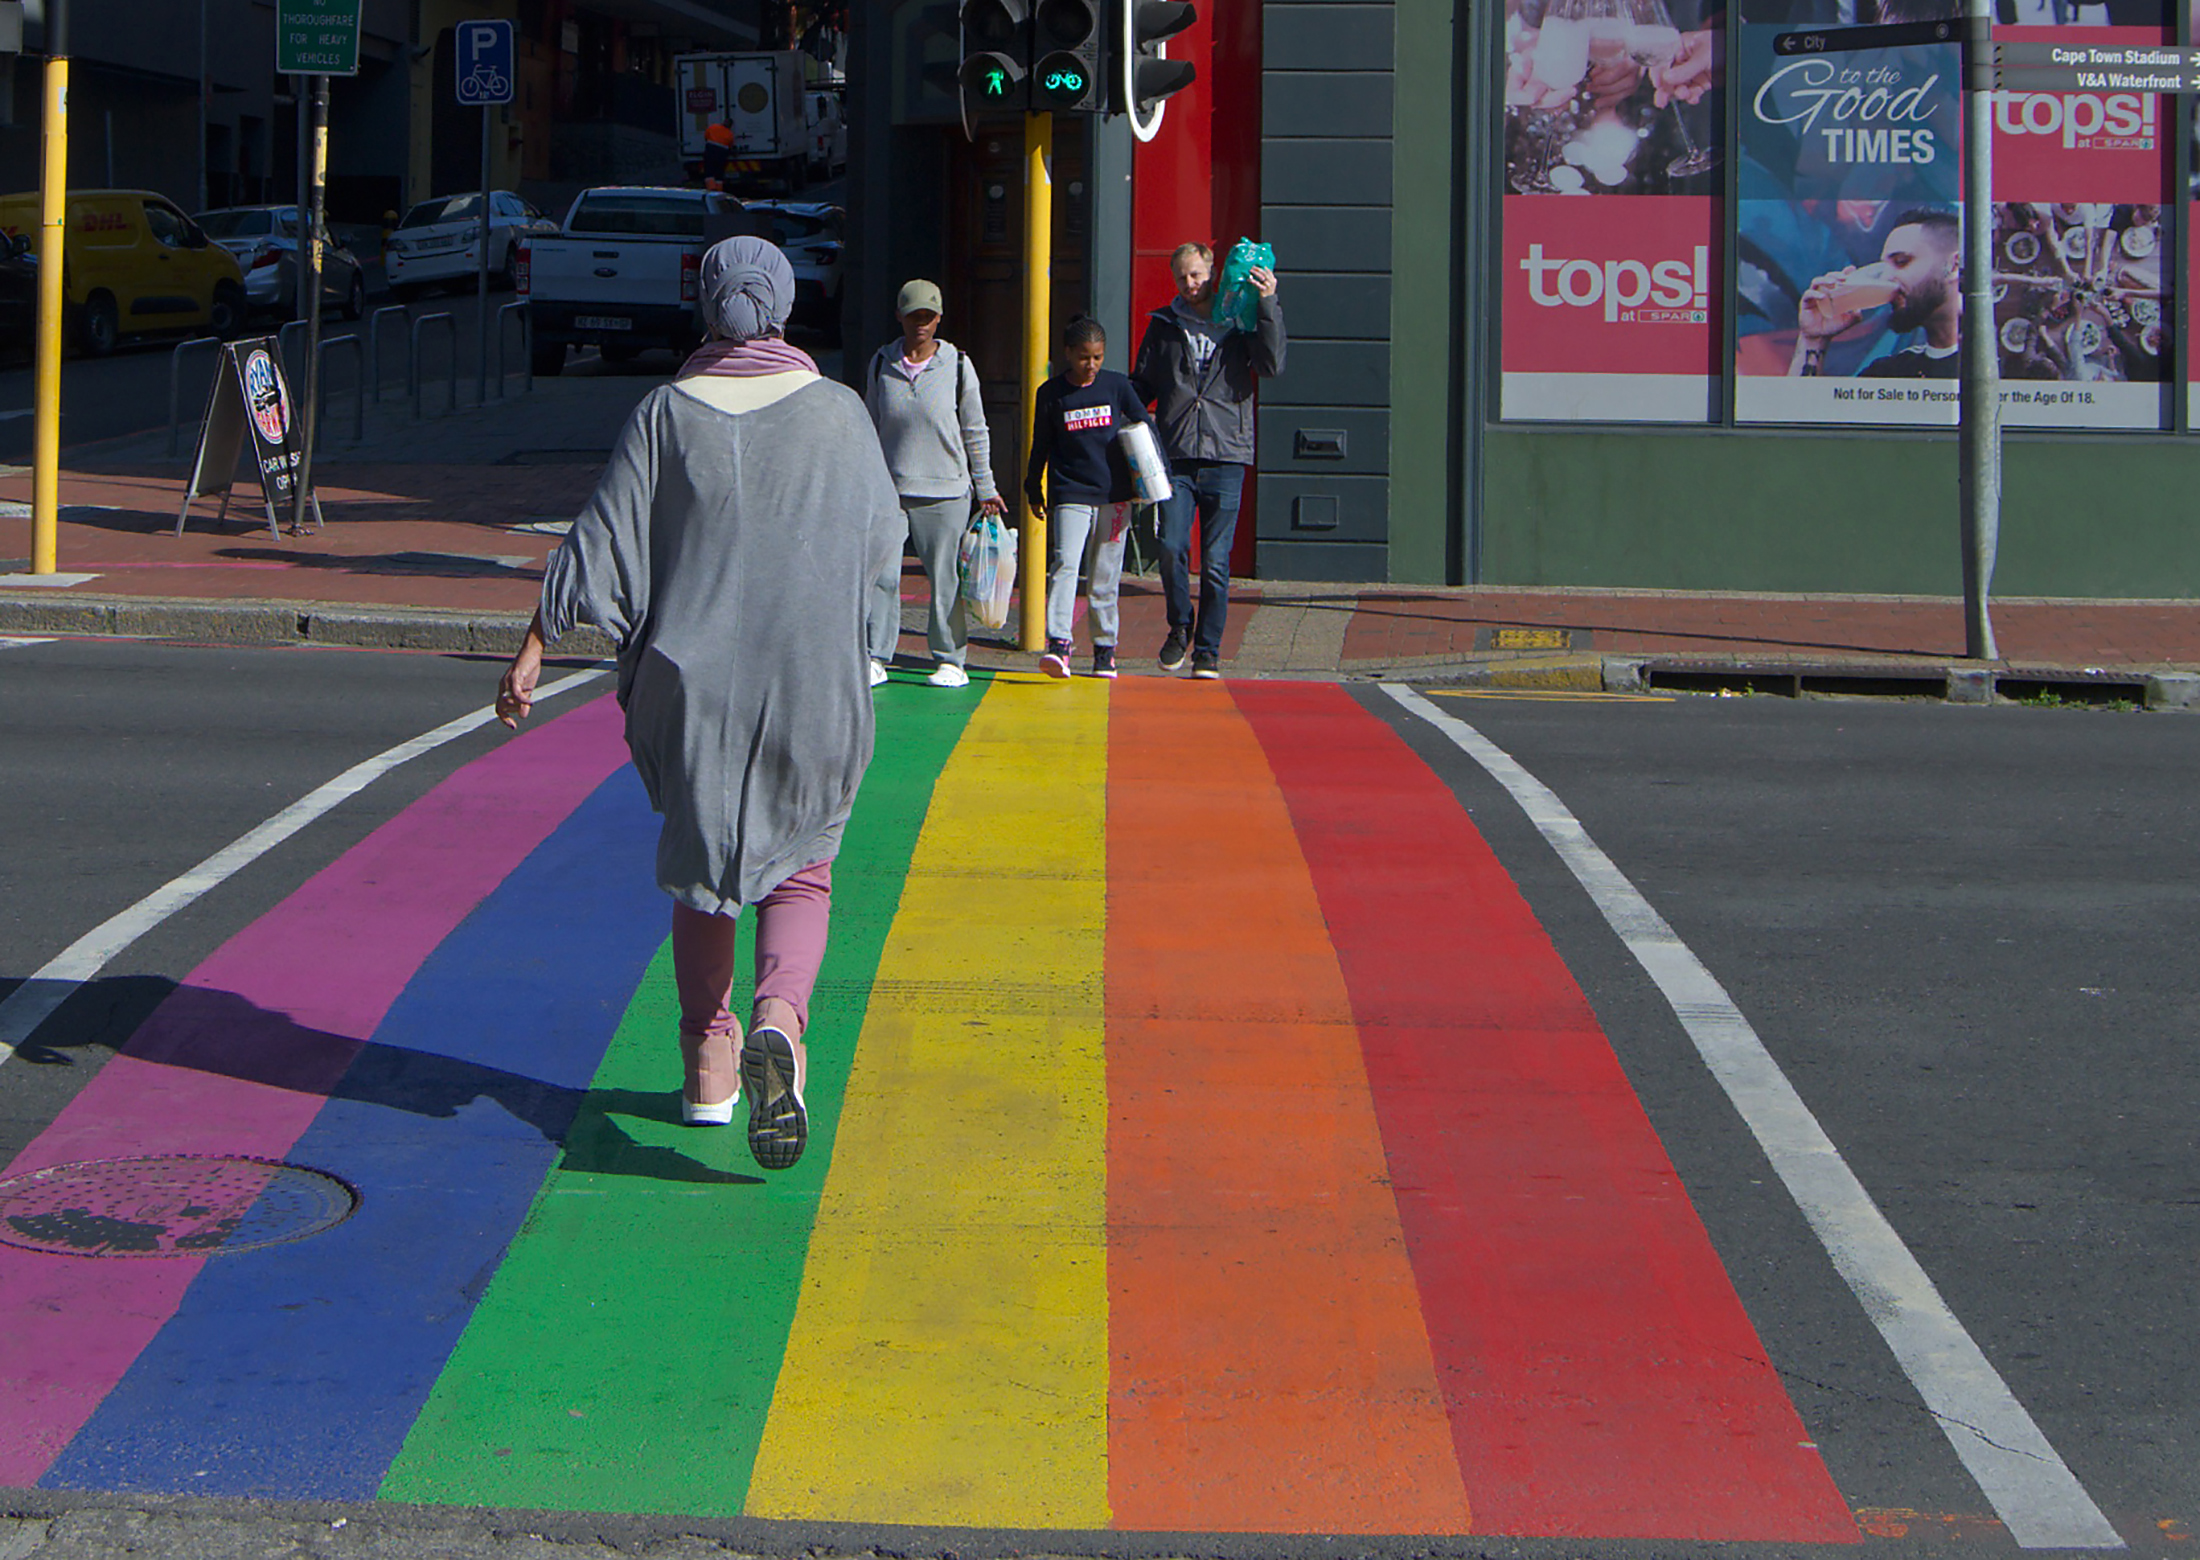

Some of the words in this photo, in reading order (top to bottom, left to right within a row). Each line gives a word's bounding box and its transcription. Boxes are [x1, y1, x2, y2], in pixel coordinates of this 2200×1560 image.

[283, 13, 355, 27] THOROUGHFARE
[289, 32, 309, 45] FOR
[318, 33, 349, 46] HEAVY
[472, 27, 498, 60] P
[1804, 35, 1826, 51] City
[296, 52, 341, 65] VEHICLES
[2051, 48, 2087, 66] Cape
[2088, 49, 2122, 63] Town
[2125, 50, 2181, 65] Stadium
[1840, 67, 1861, 84] to
[1865, 65, 1902, 85] the
[2077, 72, 2107, 87] V&A
[2109, 73, 2182, 89] Waterfront
[1753, 58, 1939, 135] Good
[1990, 90, 2155, 149] tops!
[1821, 128, 1935, 164] TIMES
[2077, 138, 2091, 148] at
[2104, 138, 2139, 148] SPAR
[80, 213, 128, 232] DHL
[1520, 243, 1708, 322] tops!
[1620, 310, 1635, 322] at
[1650, 312, 1691, 321] SPAR
[1833, 388, 1855, 400] Not
[1857, 388, 1875, 400] for
[1877, 389, 1904, 401] Sale
[1907, 389, 1919, 401] to
[2011, 391, 2032, 403] the
[2034, 391, 2056, 406] Age
[2060, 391, 2074, 404] Of
[2078, 392, 2095, 404] 18.
[1066, 407, 1109, 420] TOMMY
[262, 456, 280, 474] CAR
